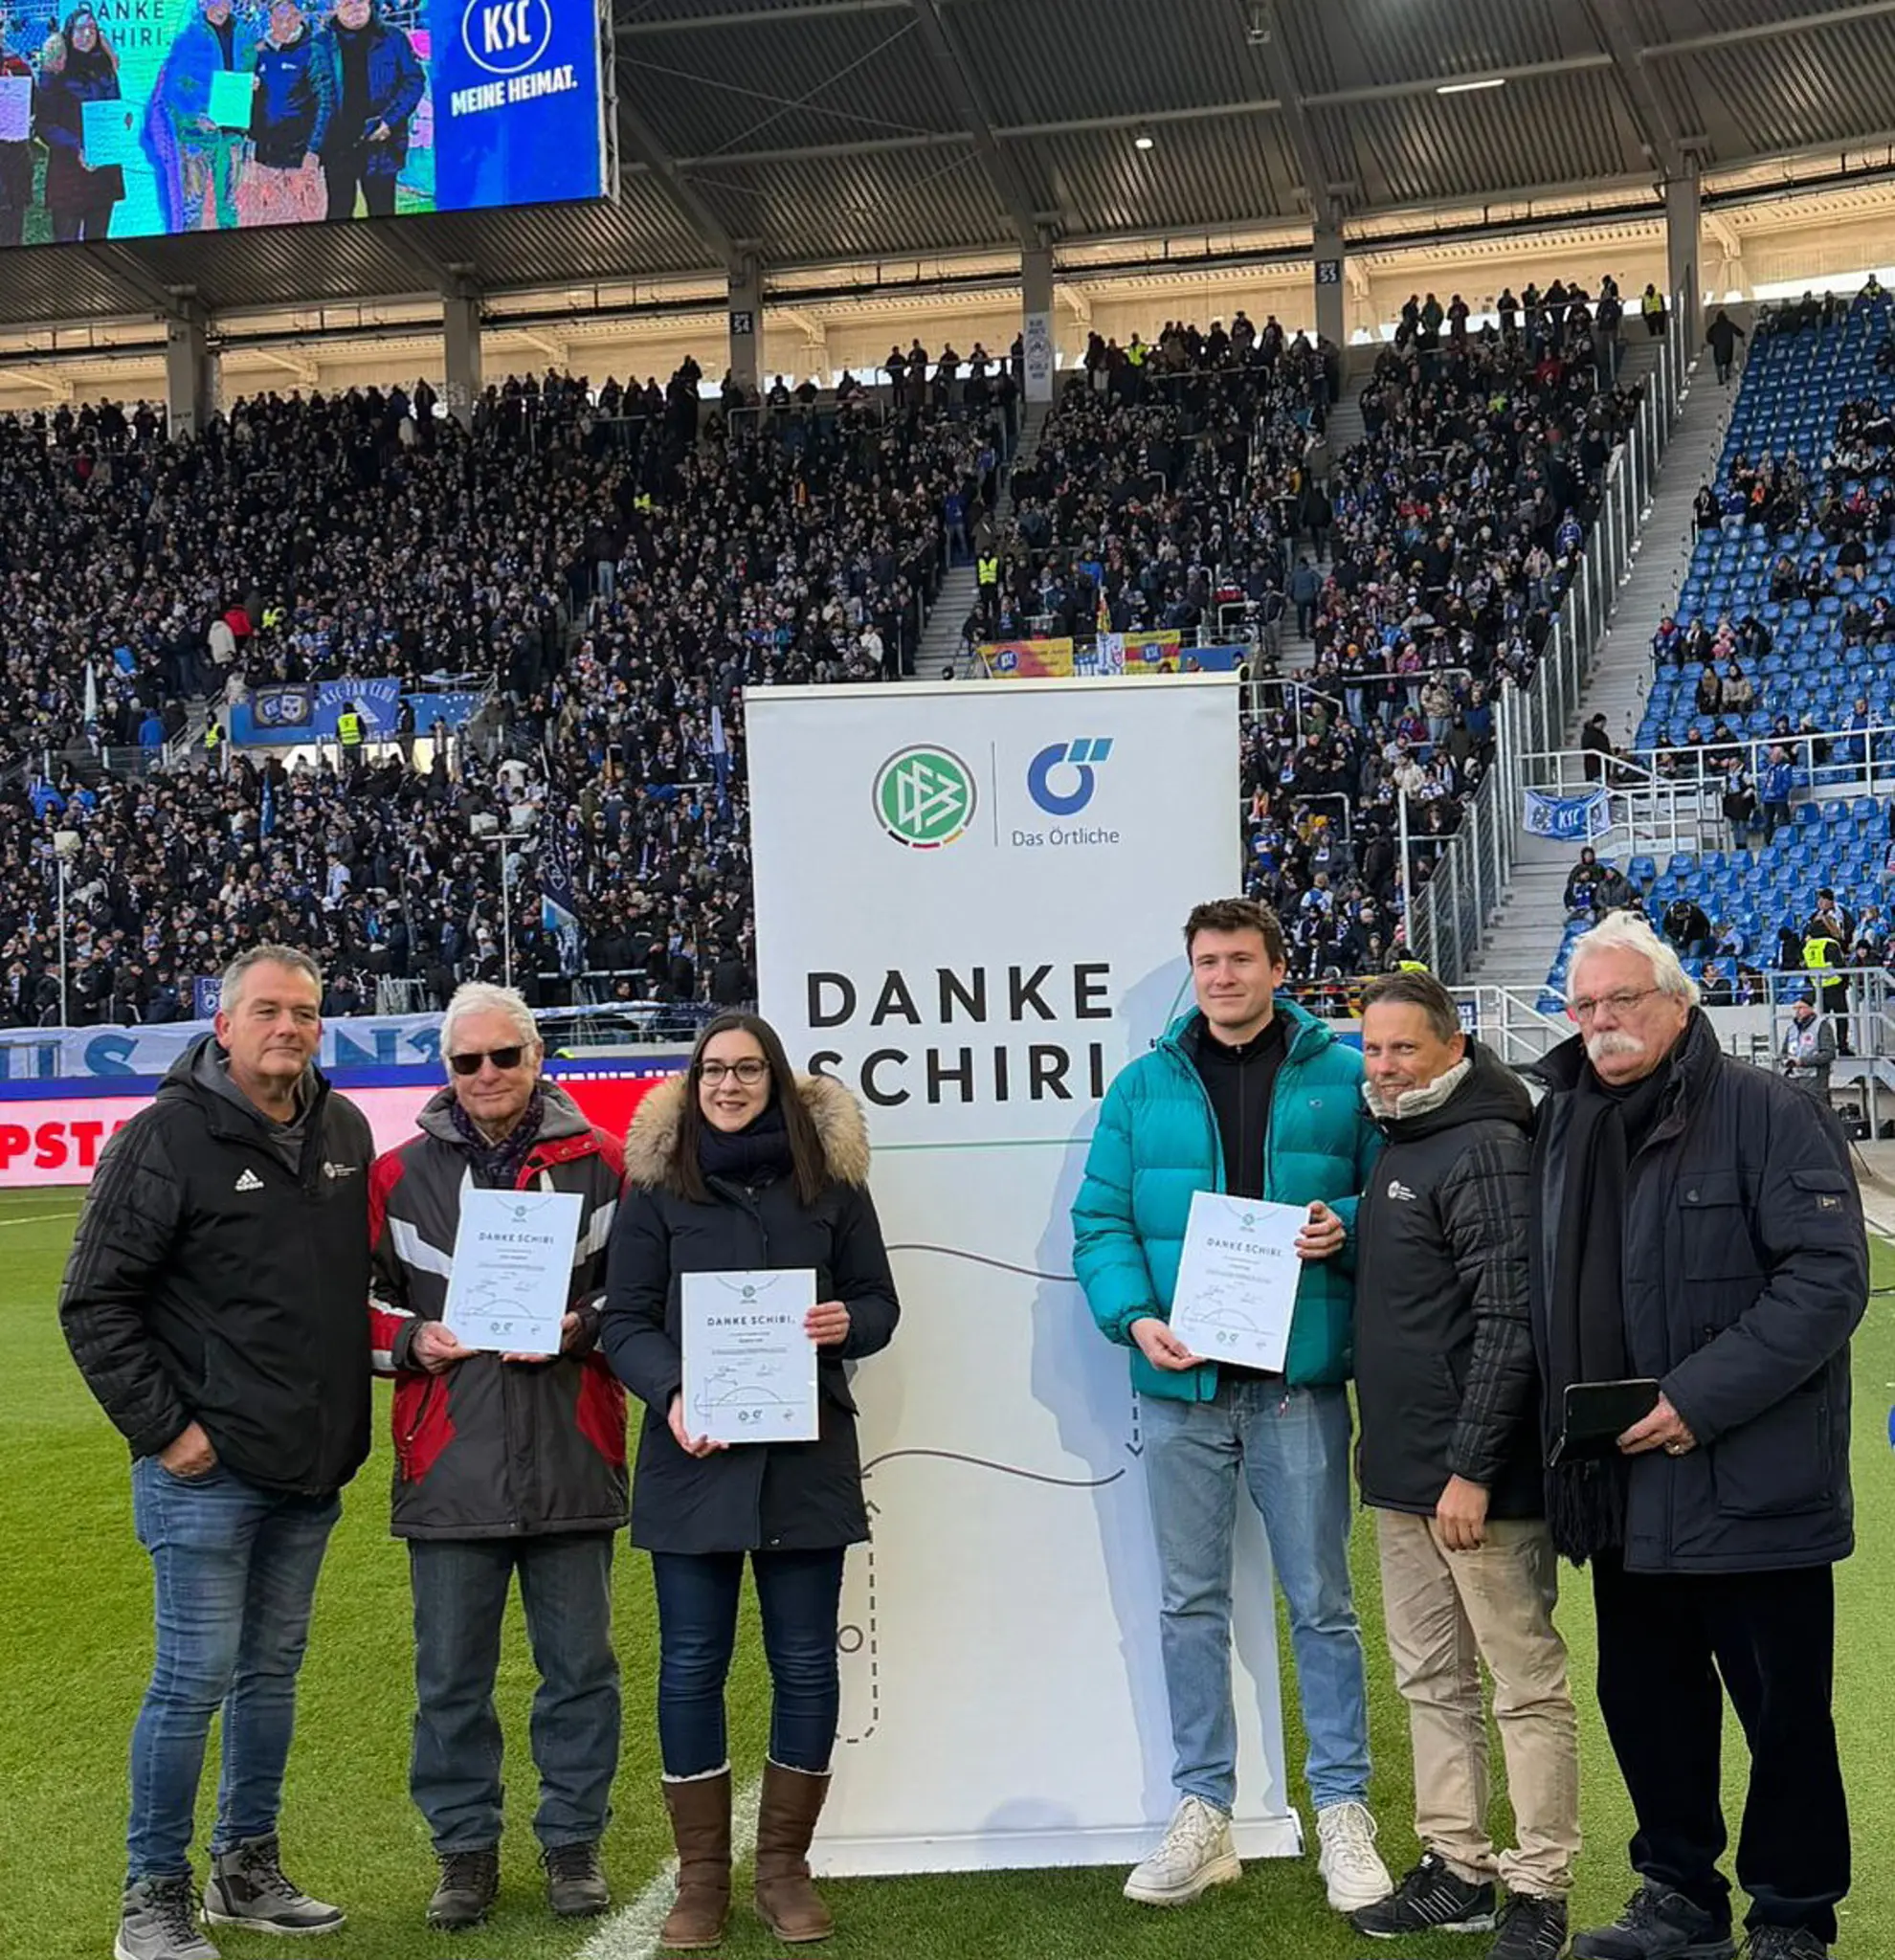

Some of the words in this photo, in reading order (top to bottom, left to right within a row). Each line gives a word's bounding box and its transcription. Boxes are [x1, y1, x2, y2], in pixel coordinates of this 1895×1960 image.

[483, 0, 531, 54] KSC
[451, 80, 505, 118] MEINE
[507, 64, 578, 103] HEIMAT.
[1012, 830, 1044, 847] Das
[1049, 826, 1120, 846] Örtliche
[807, 963, 1113, 1028] DANKE
[0, 1121, 130, 1169] PST
[707, 1316, 747, 1326] DANKE
